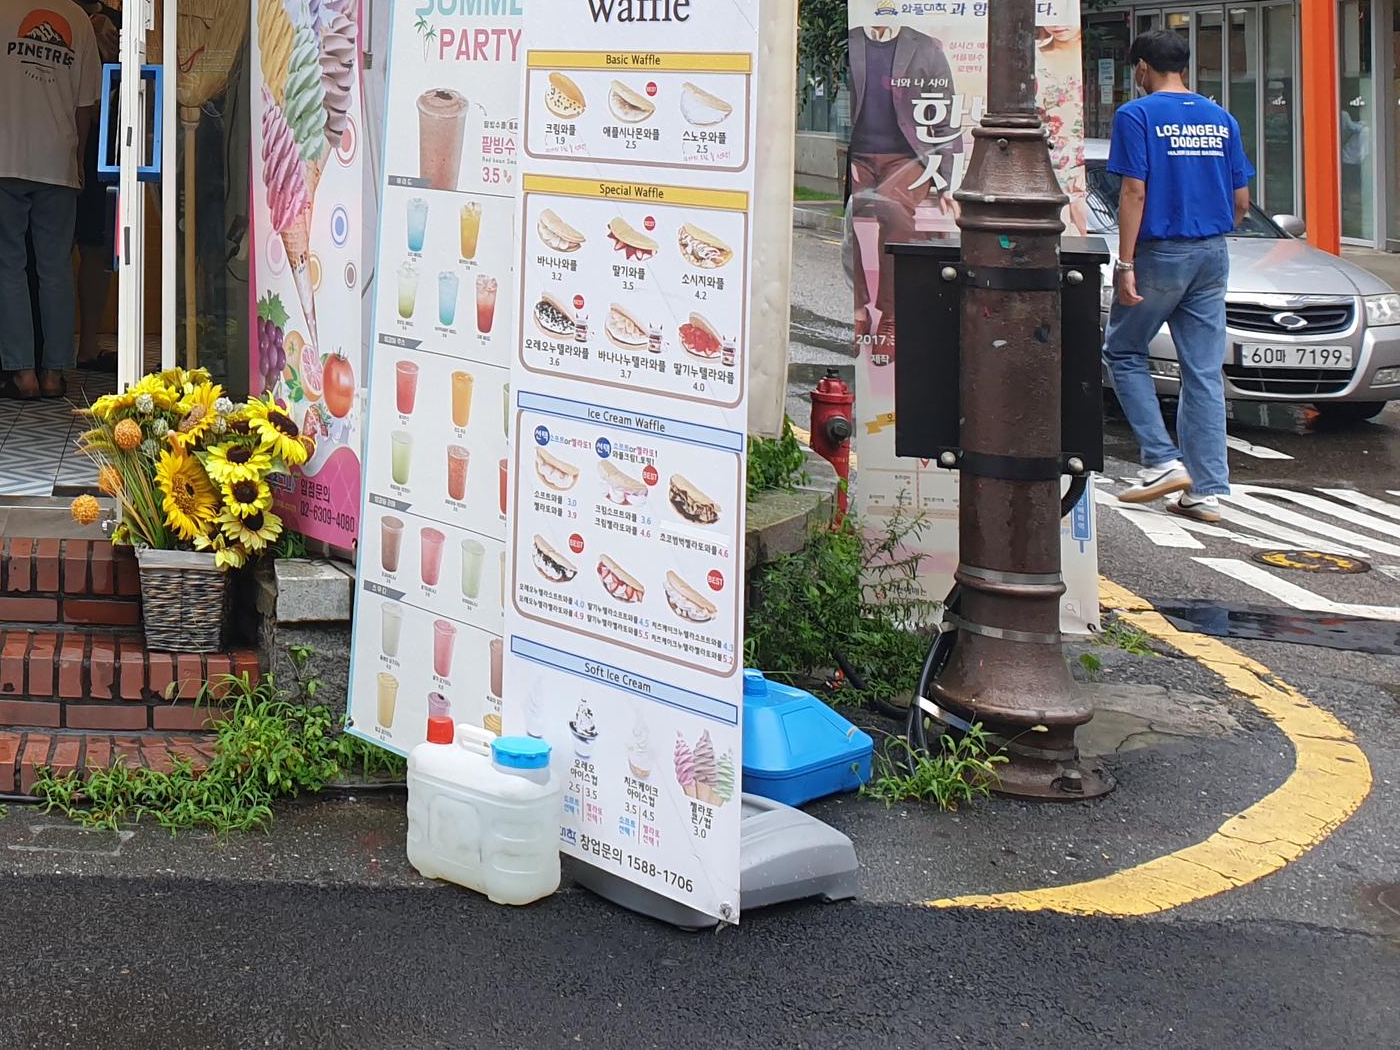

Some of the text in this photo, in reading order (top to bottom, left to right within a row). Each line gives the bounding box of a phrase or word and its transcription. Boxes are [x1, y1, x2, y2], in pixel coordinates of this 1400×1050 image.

[901, 2, 988, 17] 와플대학 과 함
[439, 29, 522, 62] PARTY
[606, 54, 661, 66] Basic Waffle
[891, 78, 948, 89] 너와 나 사이
[545, 124, 726, 145] 크림와플 애플시나몬와플 스노우와플
[1156, 124, 1229, 138] LOS ANGELES
[482, 136, 516, 156] 팥빙수
[555, 136, 565, 145] 1.9
[625, 140, 637, 150] 2.5
[696, 144, 708, 154] 2.5
[1171, 137, 1223, 149] DODGERS
[482, 167, 500, 184] 3.5
[599, 184, 664, 199] Special Waffle
[537, 256, 724, 290] 바나나와플 딸기와플 소시지와플
[552, 272, 707, 300] 3.2 3.5 4.2
[524, 339, 734, 384] 오레오누텔라와플 바나나누텔라와플 딸기누텔라와플
[1251, 347, 1342, 365] 60마 7199
[549, 357, 705, 392] 3.6 3.7 4.0
[587, 408, 666, 433] Ice Cream Waffle
[643, 470, 658, 481] BEST
[300, 479, 331, 503] 입점문의
[534, 490, 563, 505] 소프트와플
[567, 510, 577, 519] 3.9
[640, 529, 651, 538] 4.6
[569, 539, 584, 549] BEST
[718, 548, 729, 559] 4.6
[707, 575, 724, 586] BEST
[574, 598, 585, 609] 4.0
[638, 617, 650, 628] 4.5
[574, 609, 585, 620] 4.9
[638, 629, 649, 640] 5.5
[722, 654, 734, 665] 5.2
[584, 663, 652, 693] Soft Ice Cream
[574, 759, 595, 774] 오레오
[570, 768, 598, 787] 아이스컵
[568, 781, 598, 800] 2.5 3.5
[624, 776, 659, 798] 치즈케이크
[627, 788, 656, 808] 아이스컵
[624, 802, 655, 822] 3.5 4.5
[693, 826, 707, 839] 3.0
[580, 834, 623, 866] 창업문의
[627, 855, 694, 893] 1588-1706
